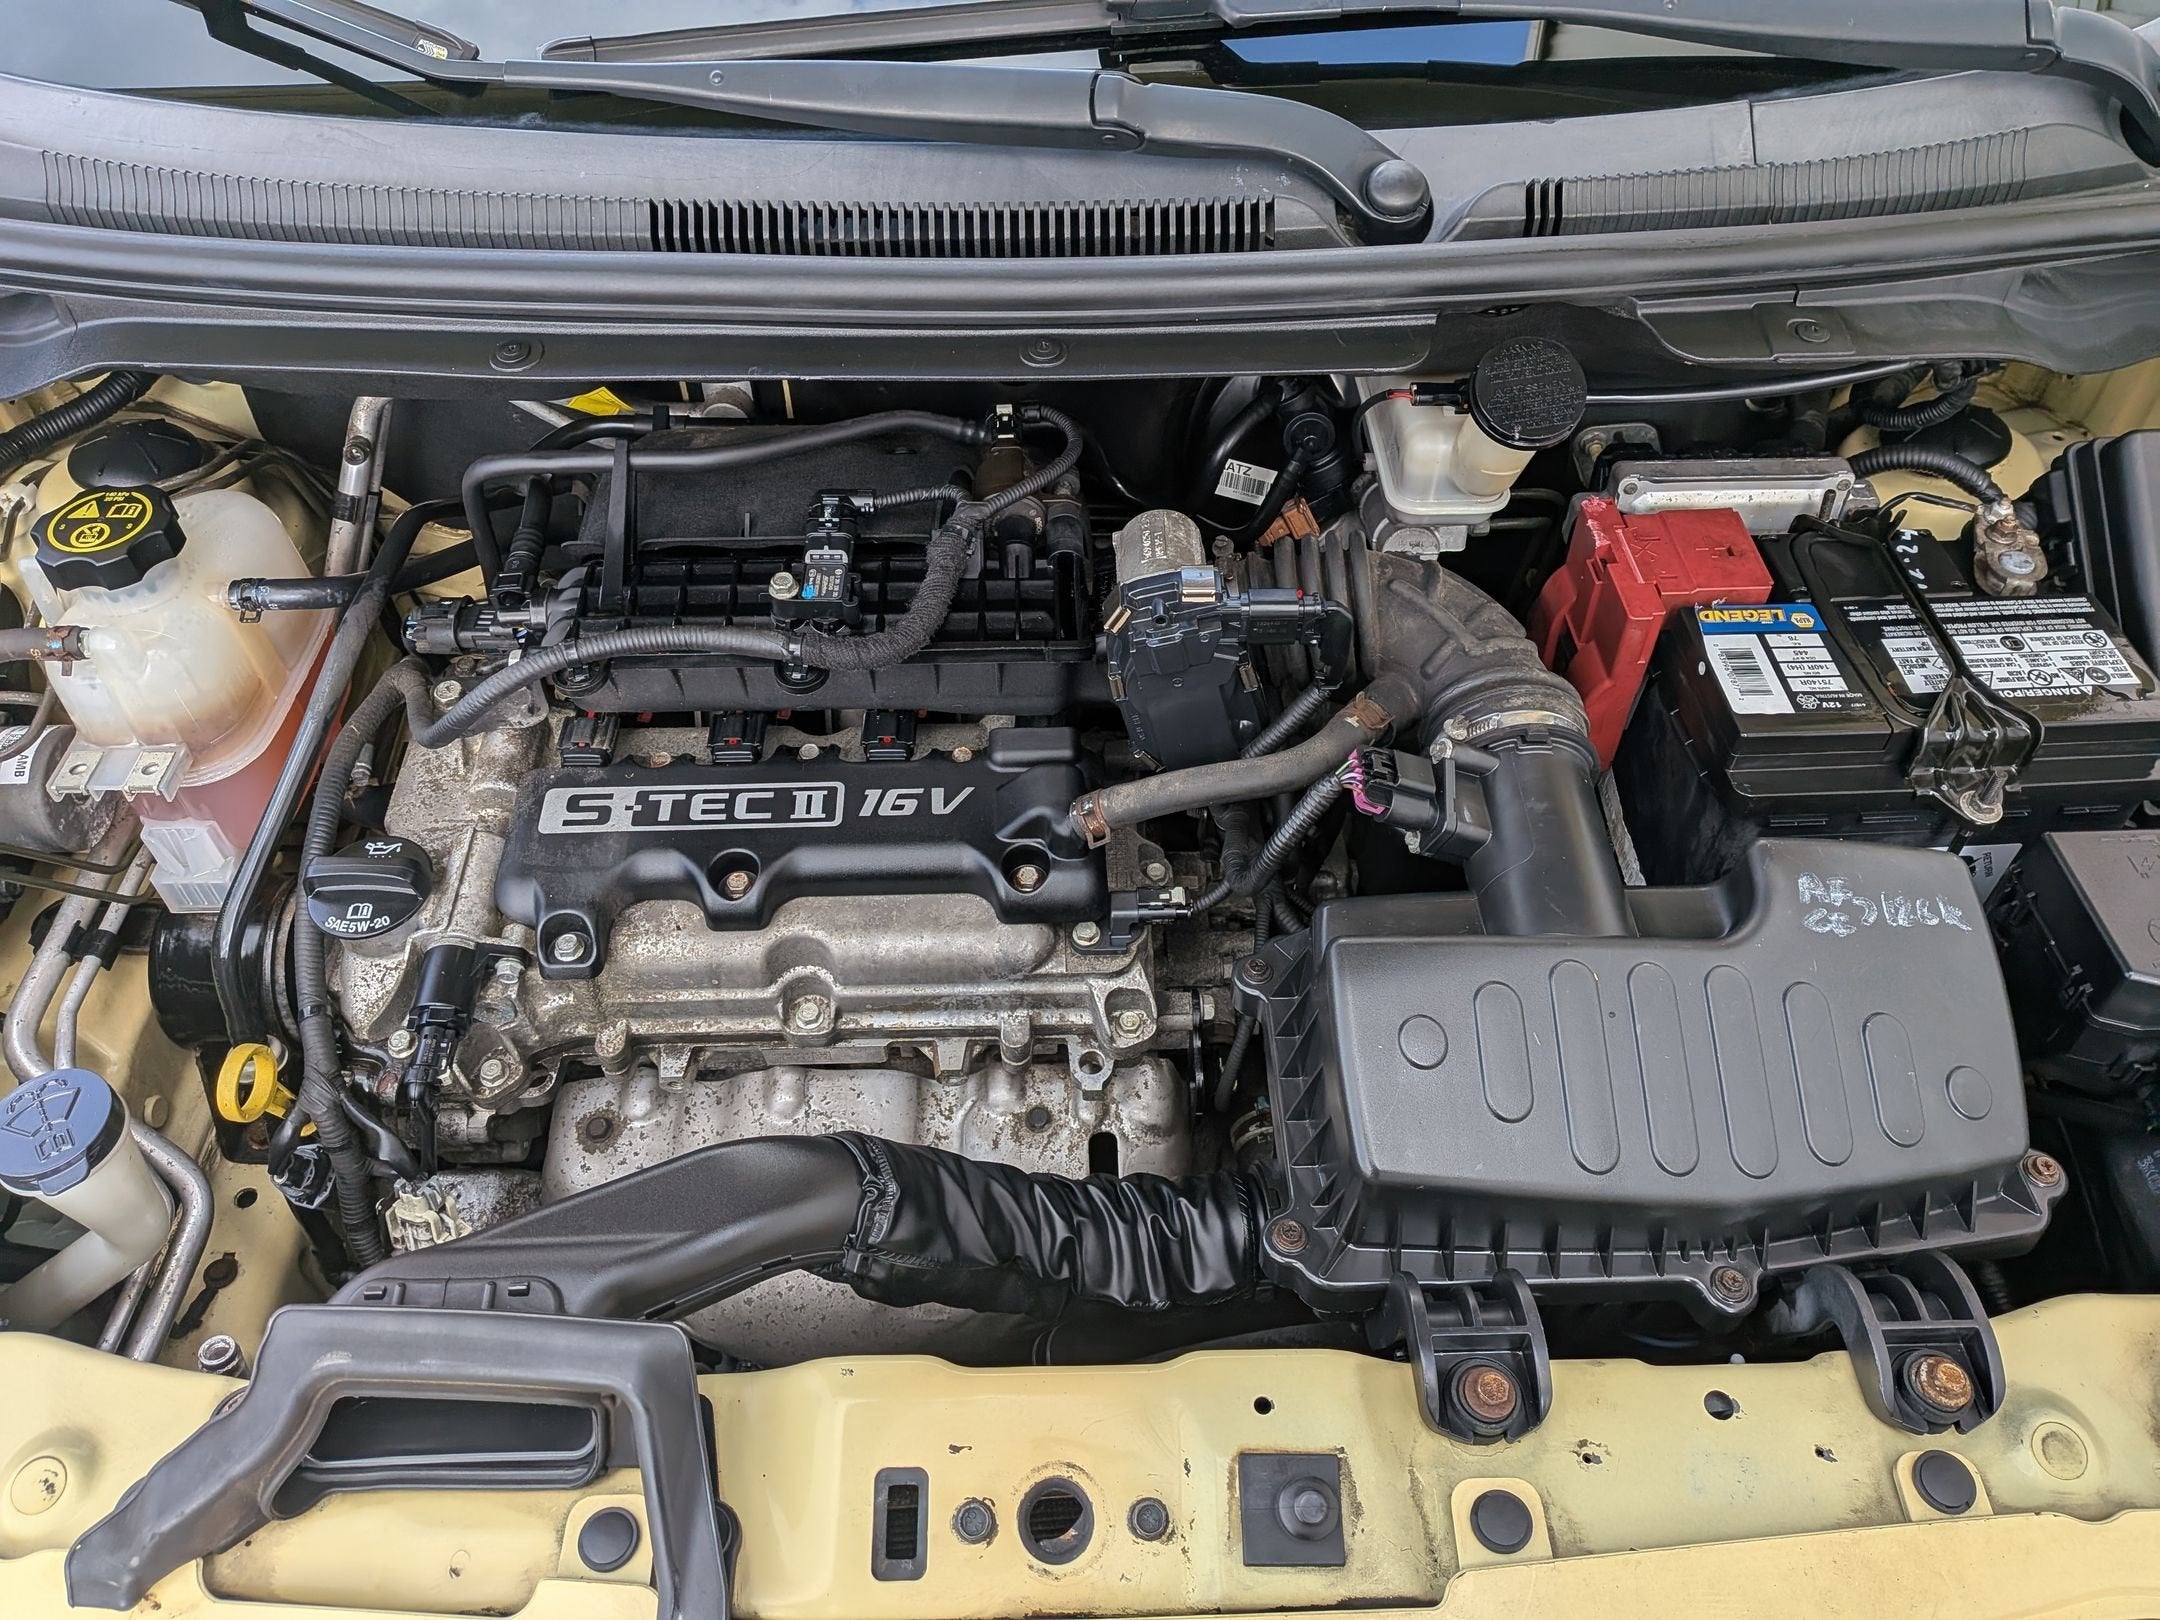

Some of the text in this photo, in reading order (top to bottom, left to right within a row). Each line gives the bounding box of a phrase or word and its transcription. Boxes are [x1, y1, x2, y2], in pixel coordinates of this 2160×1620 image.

[1226, 462, 1252, 476] ATZ
[1698, 609, 1786, 623] LEGEND
[14, 754, 29, 778] AMB
[858, 786, 976, 817] 16V
[1982, 852, 1994, 878] RETURN
[324, 915, 390, 934] SAE5W-20
